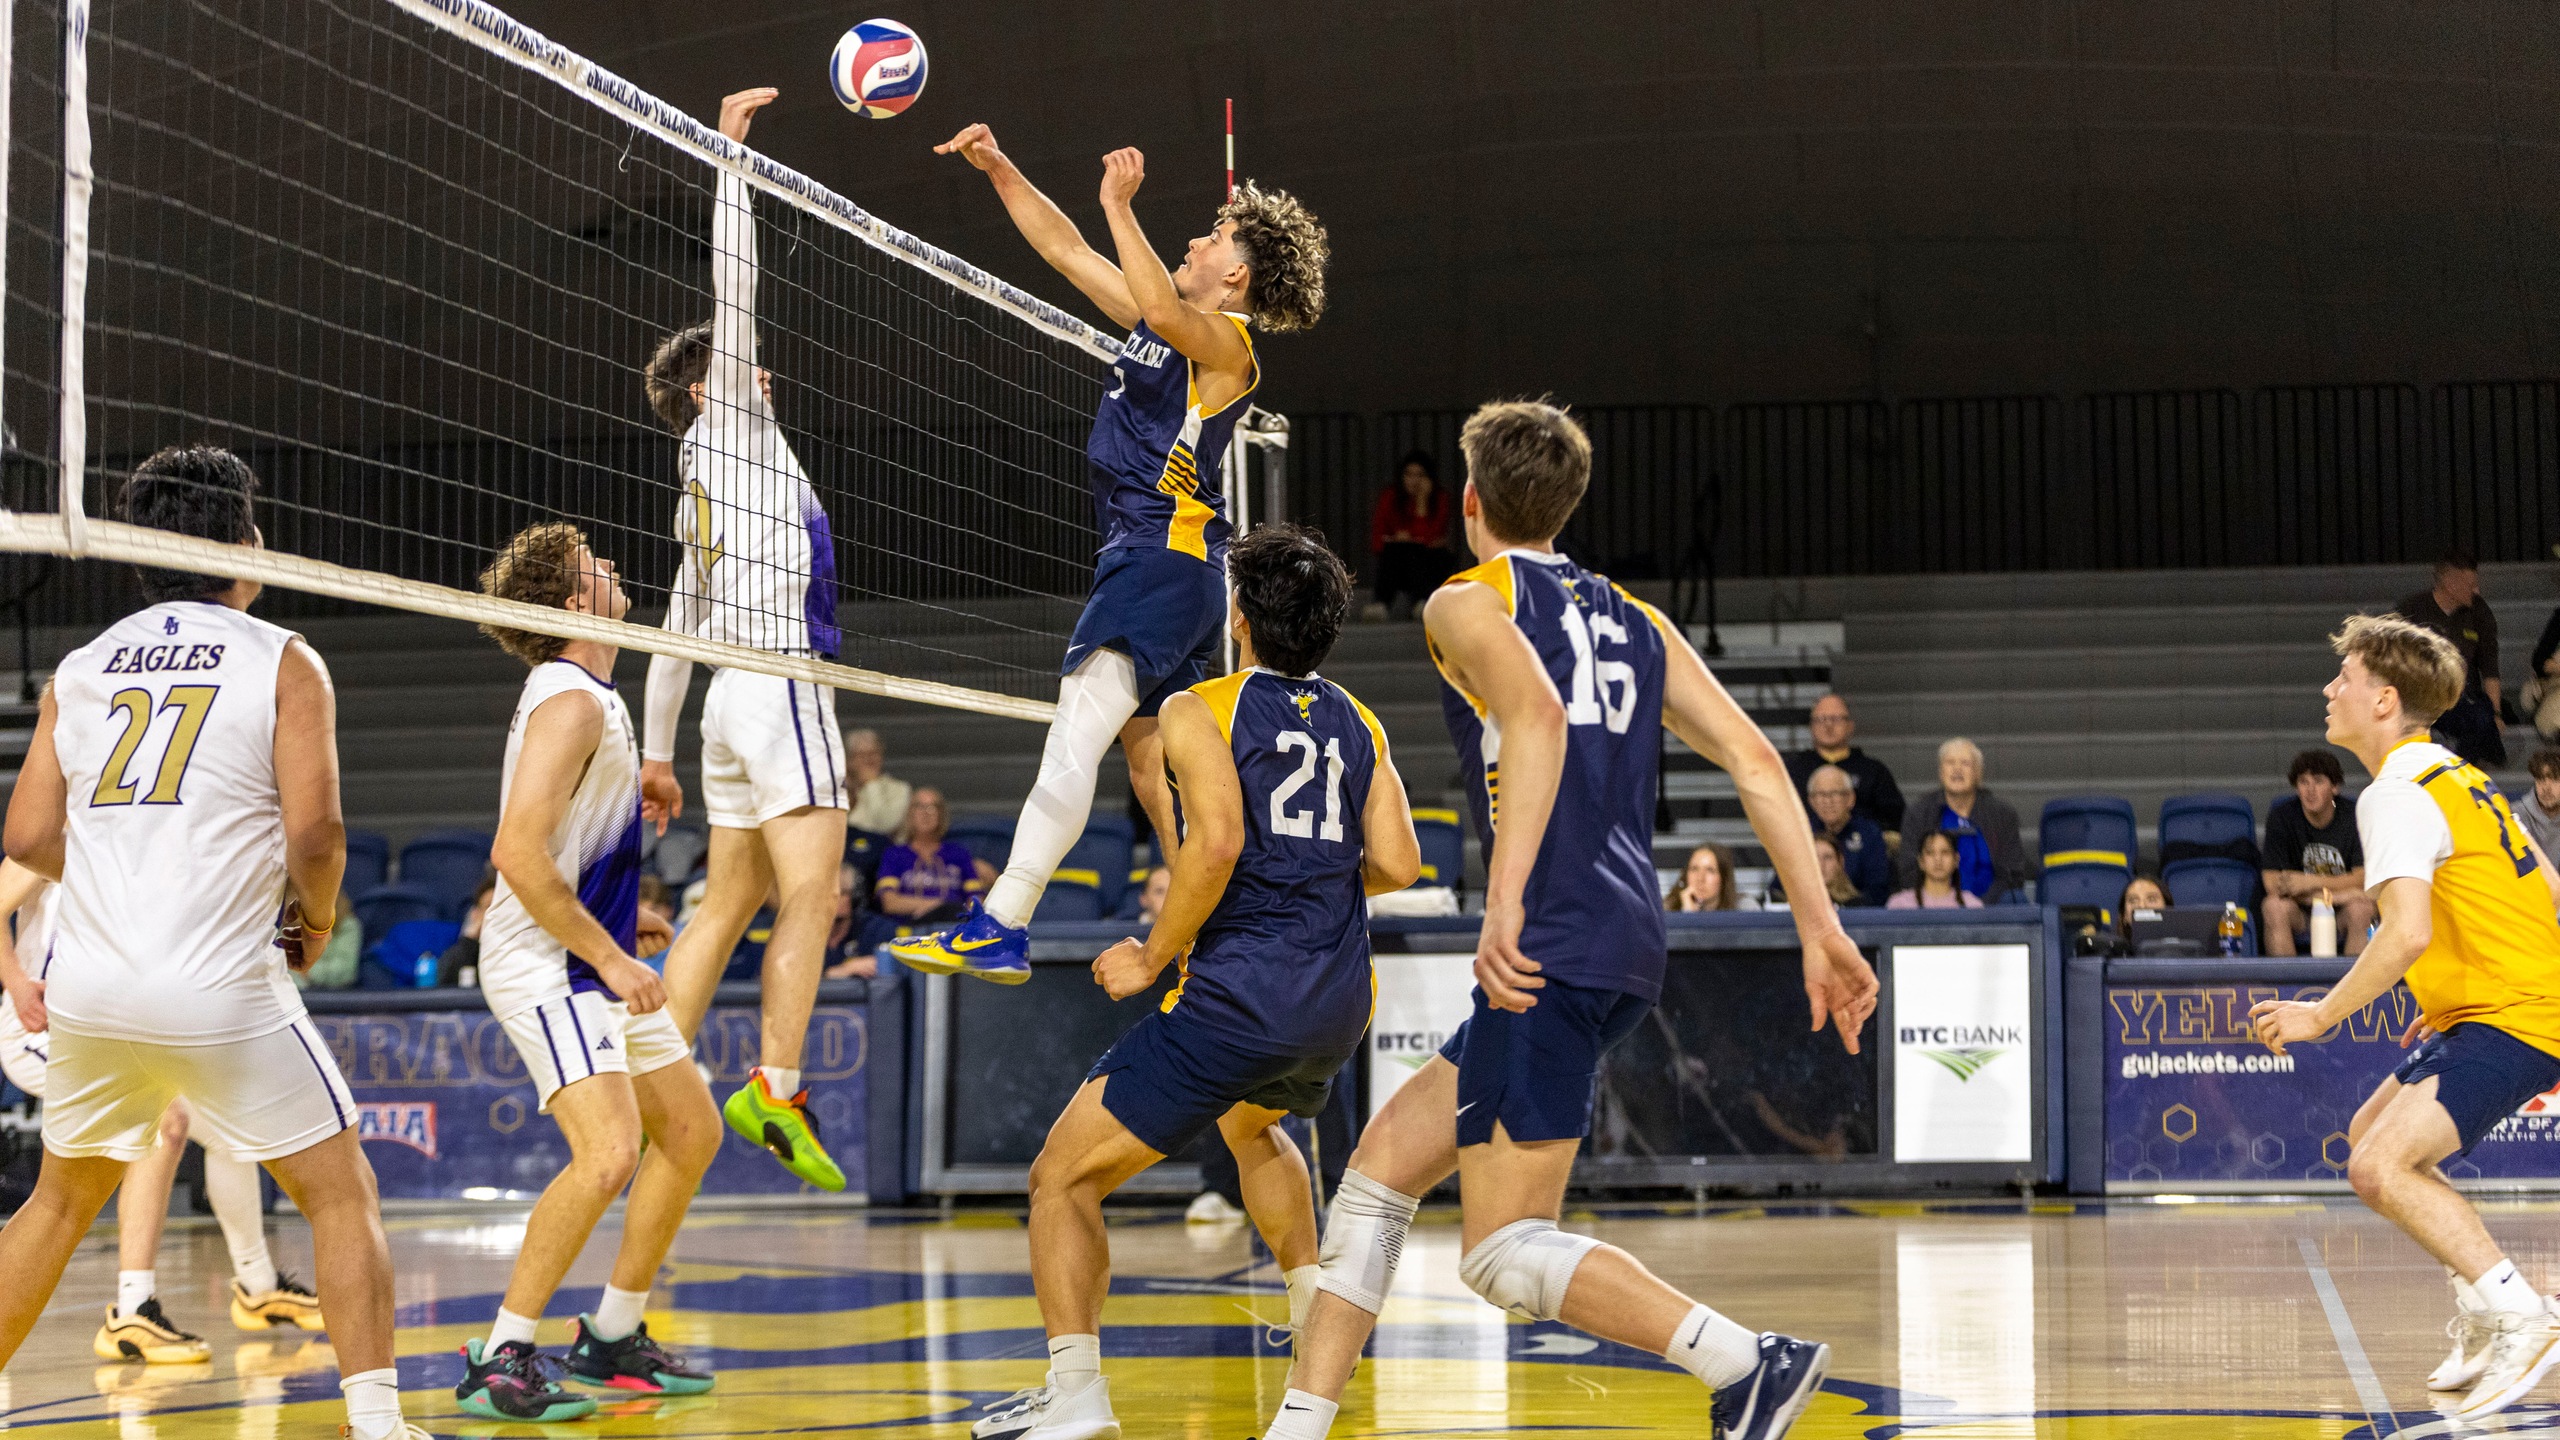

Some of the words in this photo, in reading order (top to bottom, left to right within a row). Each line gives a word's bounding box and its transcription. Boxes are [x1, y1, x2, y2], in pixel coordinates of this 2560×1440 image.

[464, 1, 567, 70] YELLOWJACTS
[102, 644, 226, 674] EAGLES
[1559, 602, 1637, 735] 16
[89, 684, 221, 808] 27
[1270, 730, 1345, 843] 21
[1378, 1031, 1424, 1051] BTC
[1901, 1026, 1948, 1044] BTC
[1953, 1025, 2023, 1045] BANK
[2122, 1051, 2295, 1079] gujackets.com
[358, 1110, 427, 1143] AIA
